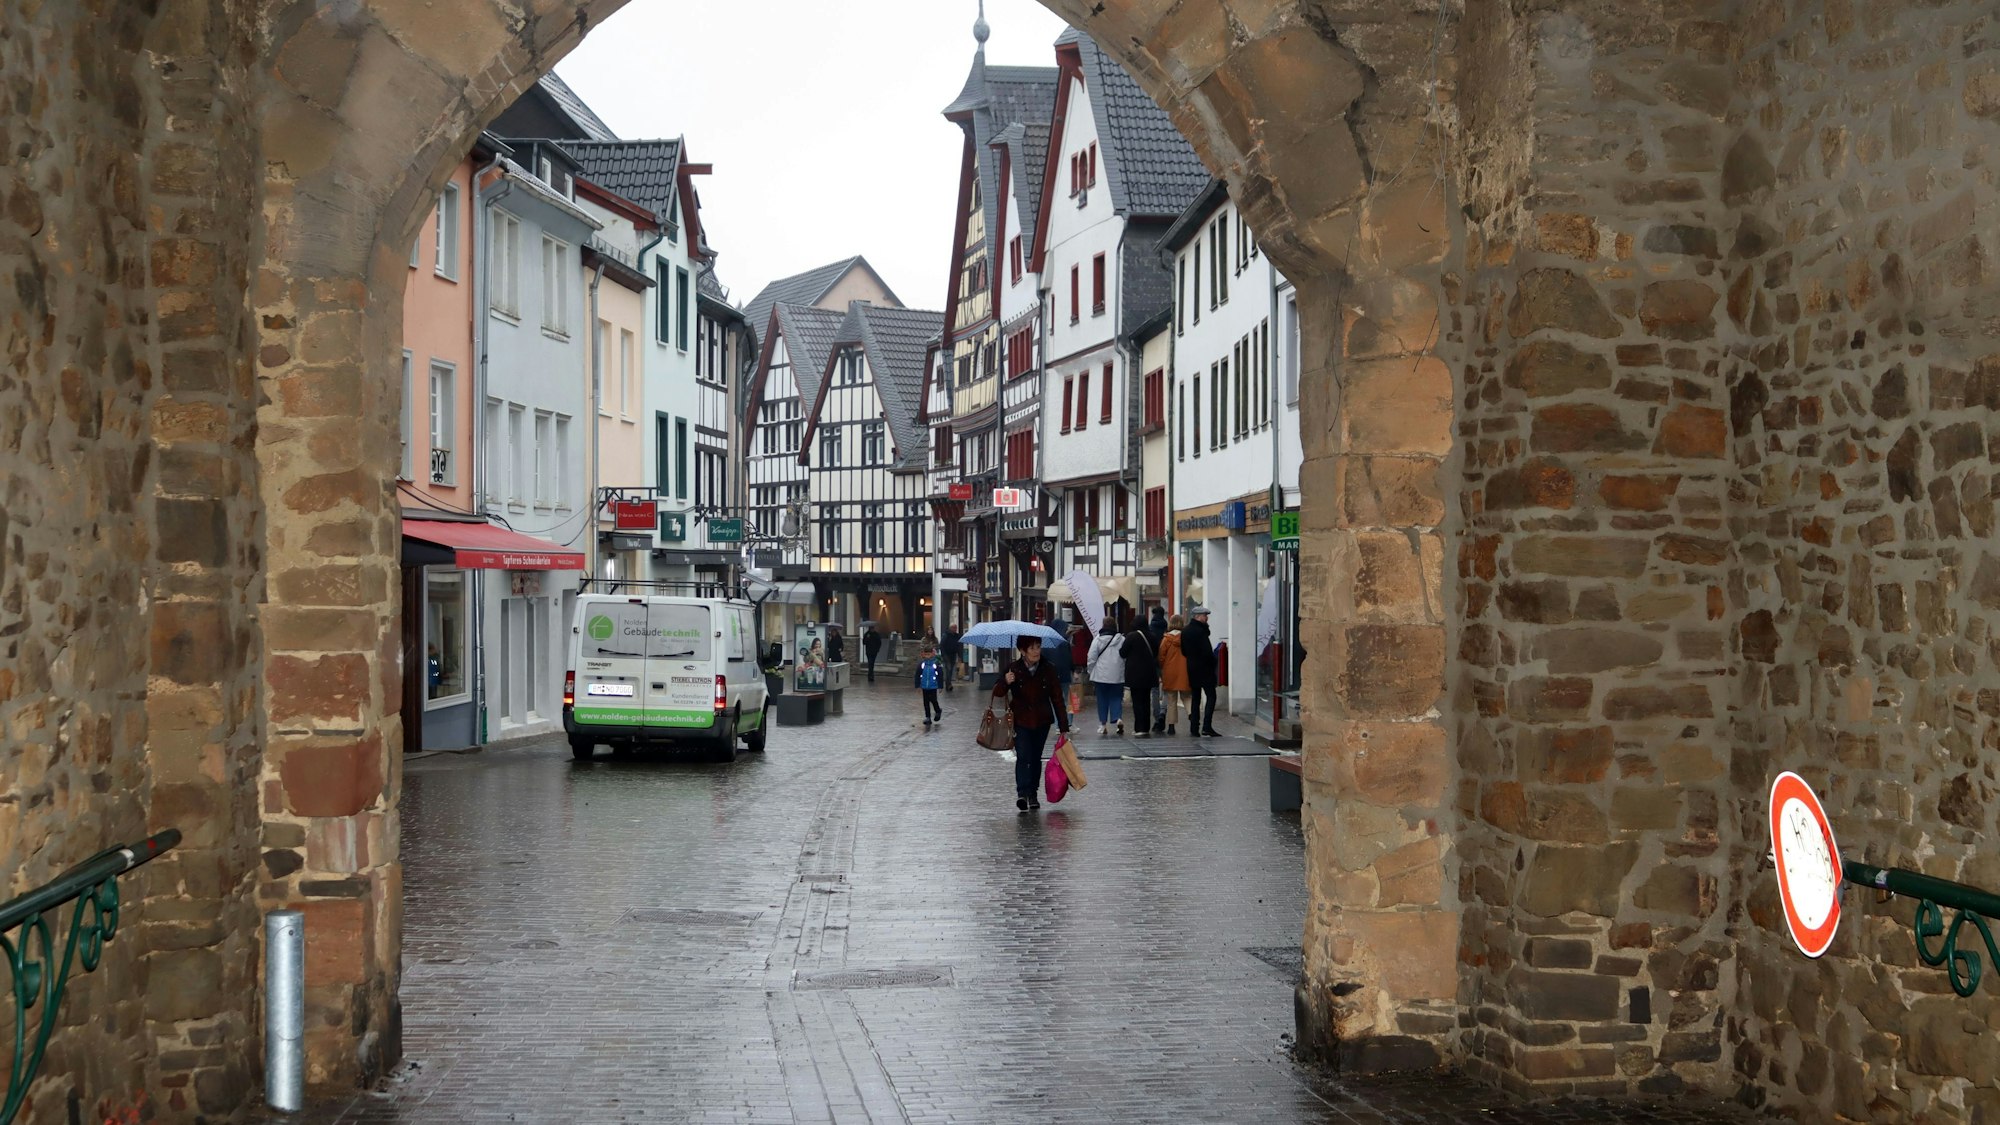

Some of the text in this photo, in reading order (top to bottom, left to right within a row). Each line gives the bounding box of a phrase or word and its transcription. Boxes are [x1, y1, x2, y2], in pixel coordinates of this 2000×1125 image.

[711, 525, 737, 537] Kneipp
[1278, 517, 1298, 535] Bi
[623, 627, 701, 637] Gebäudetechnik
[580, 712, 706, 723] www.nolden-gebäudetechnik.de
